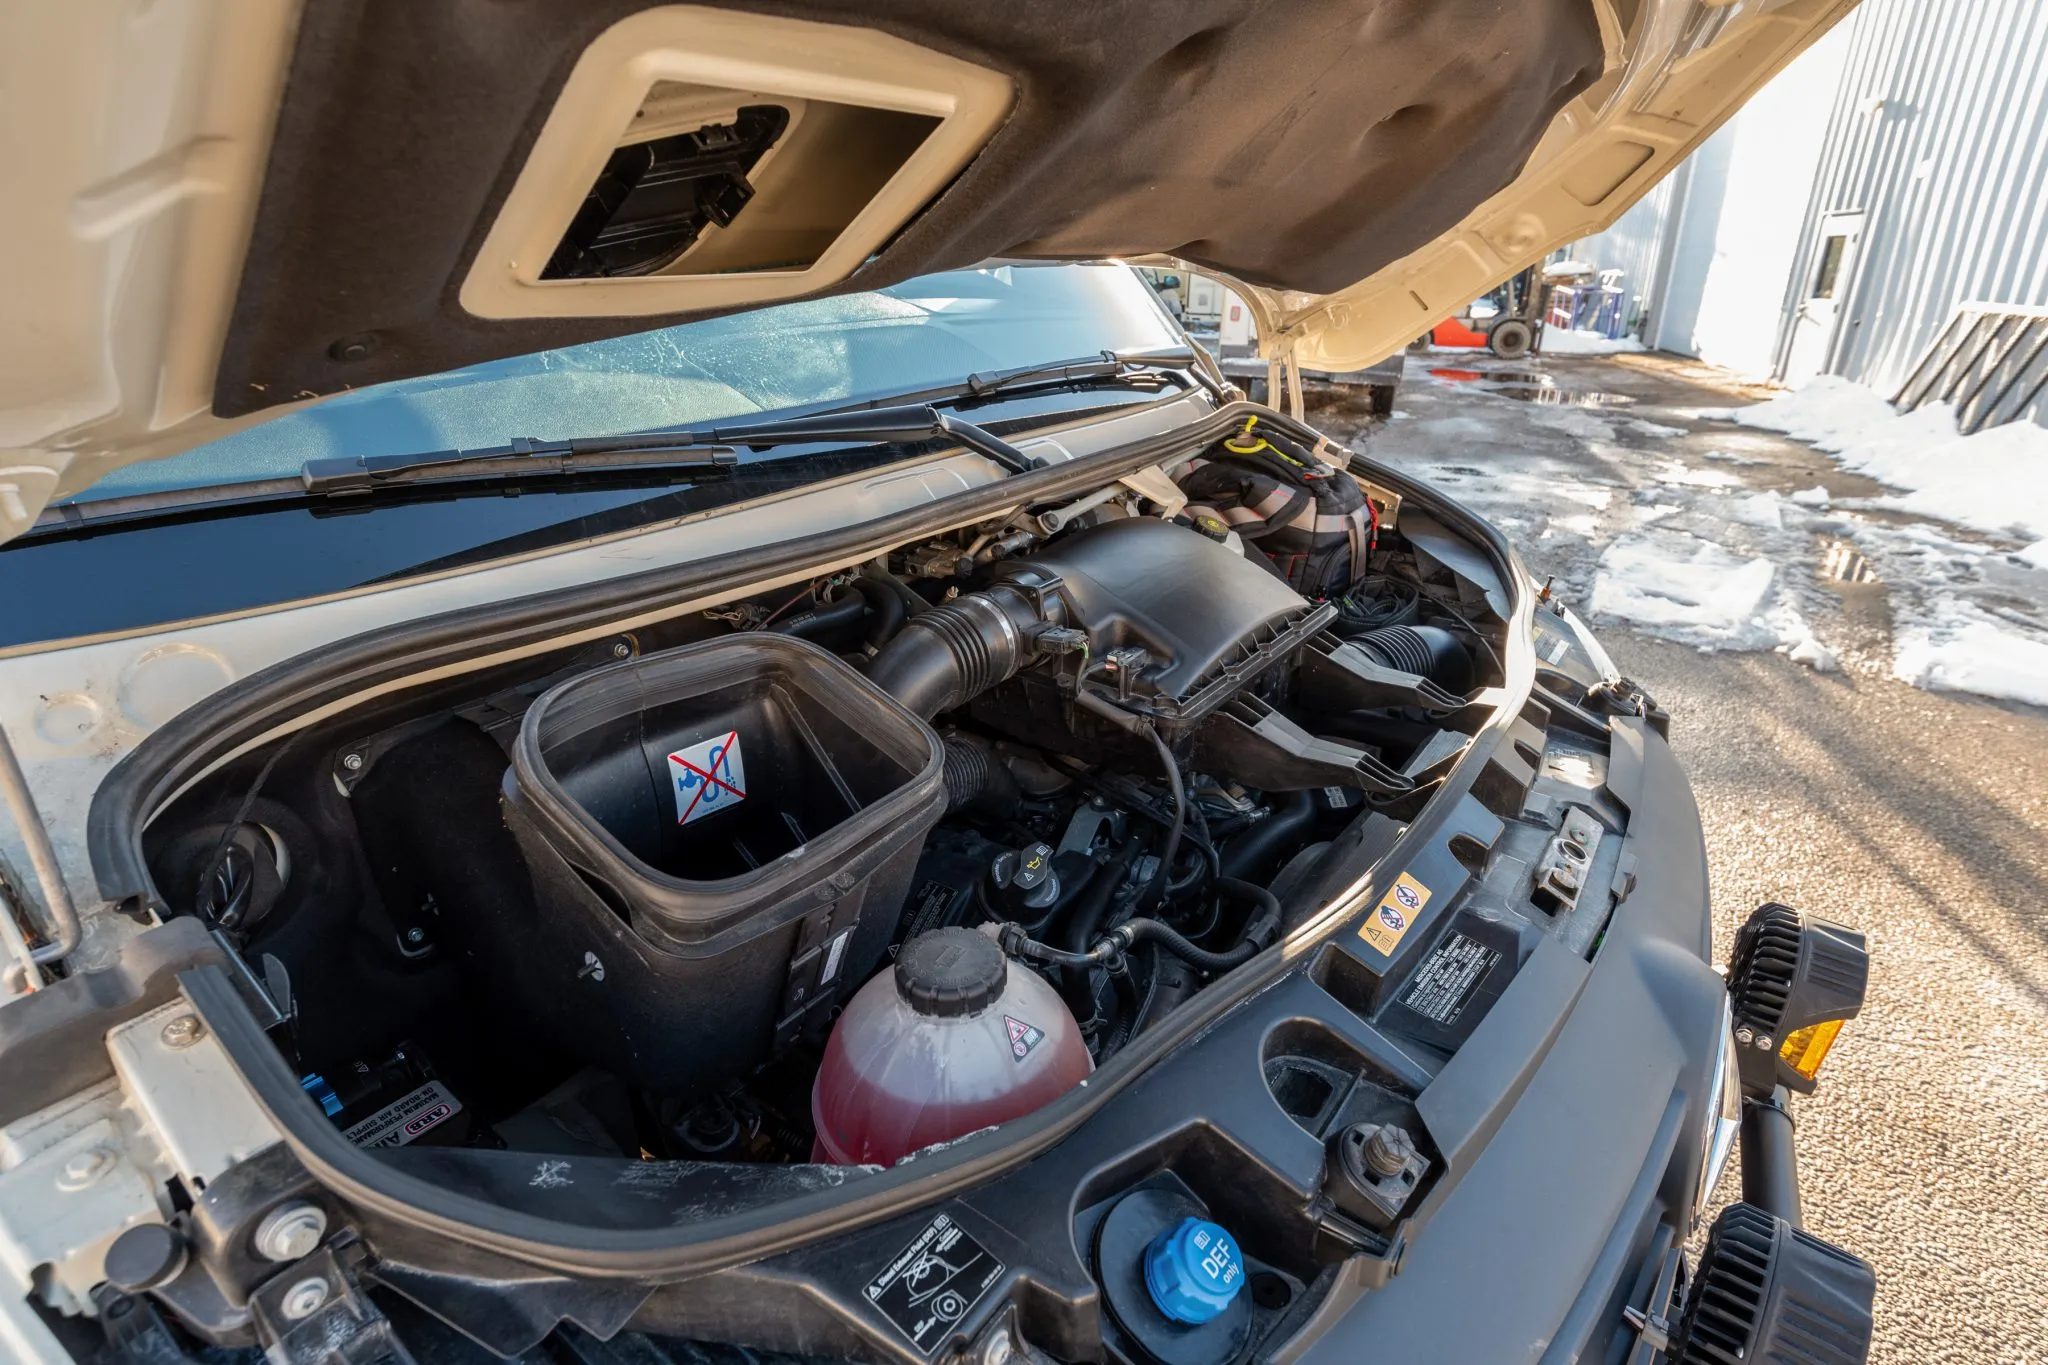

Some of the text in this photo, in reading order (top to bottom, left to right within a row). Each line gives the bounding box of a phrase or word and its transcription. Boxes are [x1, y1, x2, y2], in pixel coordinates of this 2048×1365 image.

[377, 1111, 393, 1121] AIR
[409, 1107, 444, 1132] ARB
[877, 1267, 897, 1287] Diesel
[891, 1249, 914, 1271] Exhaust
[909, 1238, 925, 1254] Fluid
[1200, 1237, 1231, 1280] DEF
[1222, 1261, 1240, 1285] only
